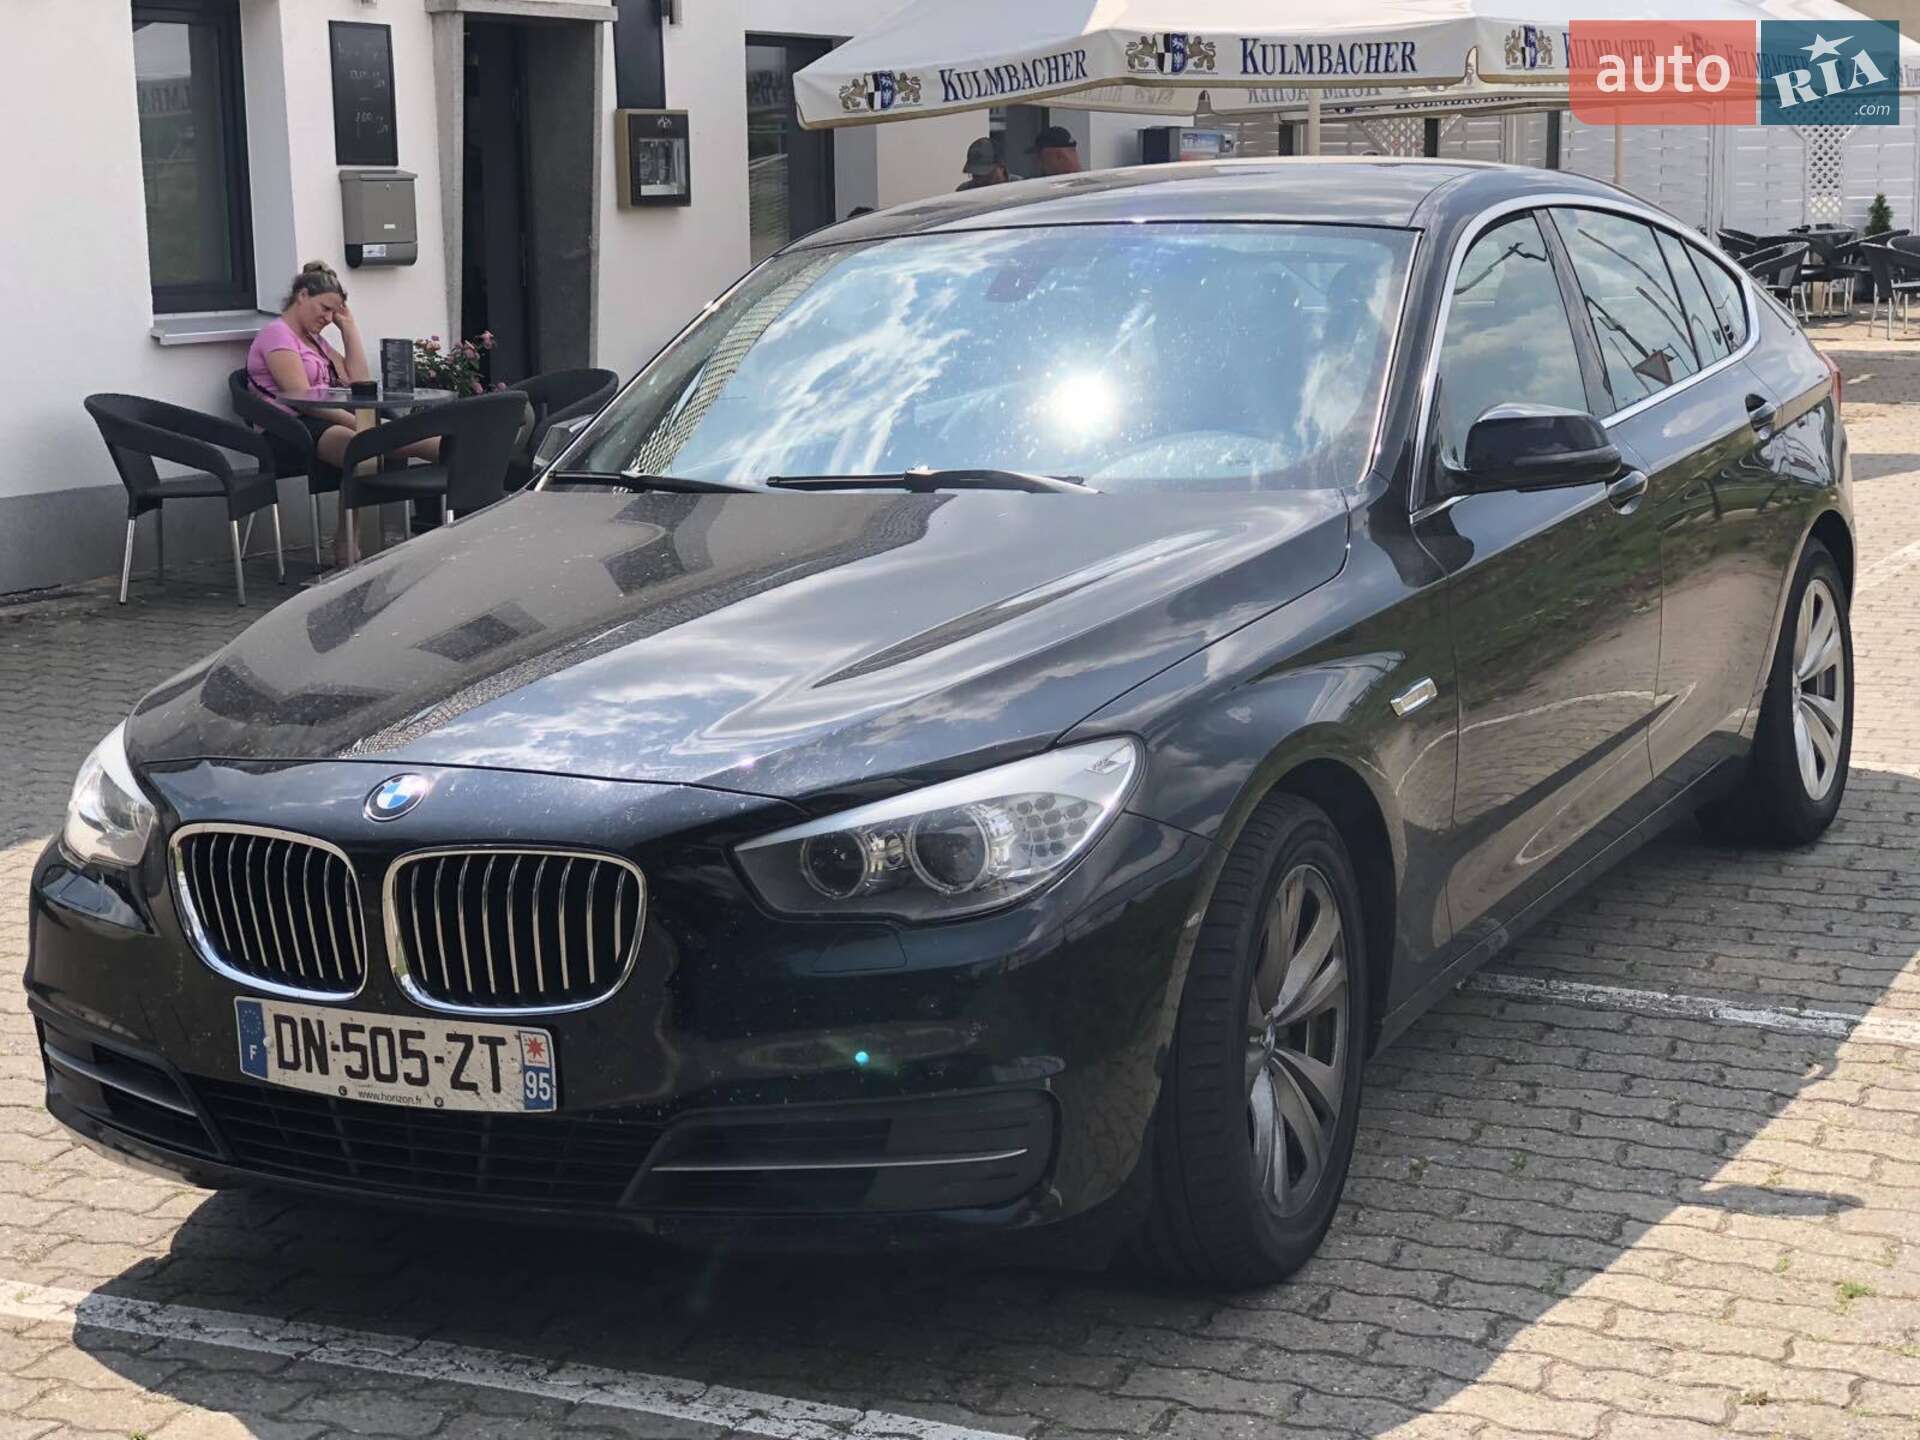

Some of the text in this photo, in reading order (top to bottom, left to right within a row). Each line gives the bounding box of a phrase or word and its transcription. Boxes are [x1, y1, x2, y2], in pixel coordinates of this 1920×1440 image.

[1240, 38, 1418, 75] KULMBACHER
[939, 49, 1089, 102] KULMBACHER
[249, 1044, 257, 1060] F
[274, 1013, 507, 1094] DN-505-ZT
[525, 1070, 551, 1101] 95
